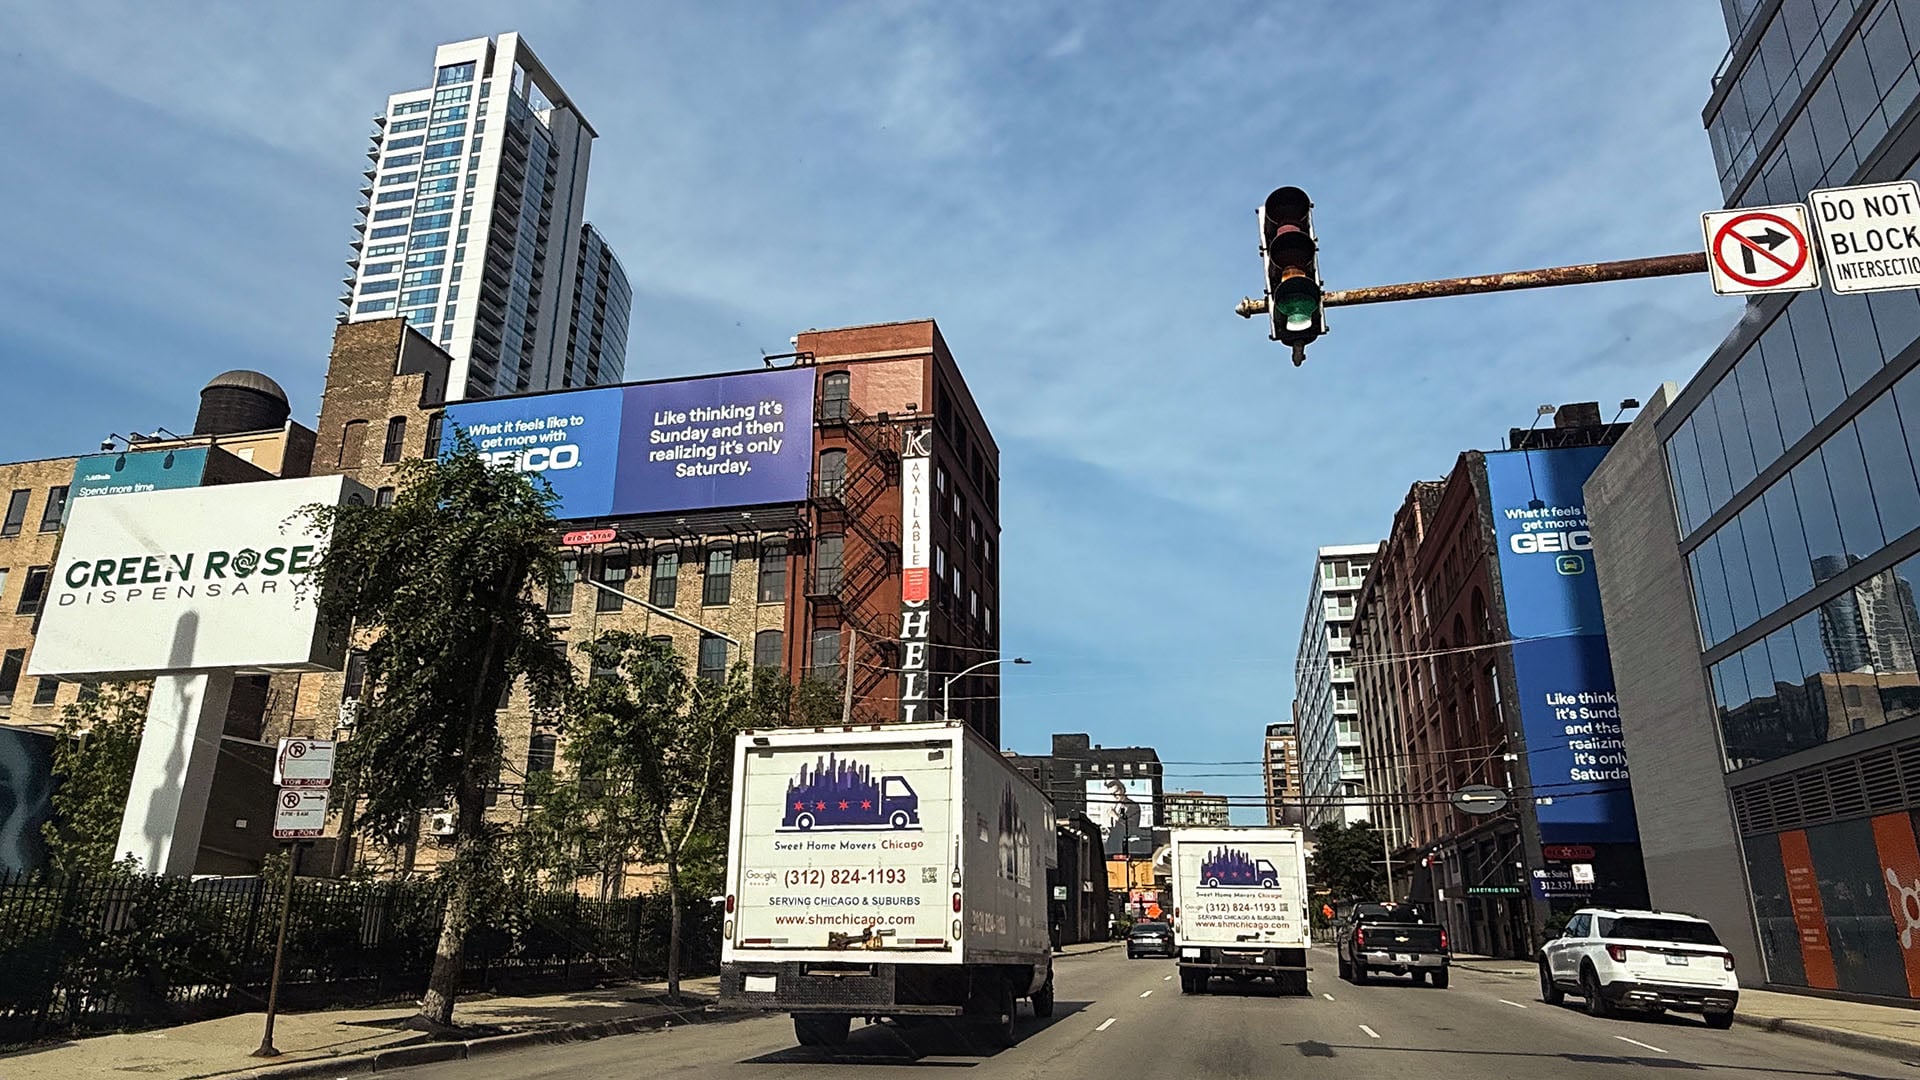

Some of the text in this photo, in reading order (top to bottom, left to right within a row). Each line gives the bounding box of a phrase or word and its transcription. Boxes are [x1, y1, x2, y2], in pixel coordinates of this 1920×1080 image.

[1821, 193, 1910, 221] DO NOT
[1831, 227, 1920, 254] BLOCK
[654, 400, 783, 426] Like thinking it's
[468, 414, 584, 437] What it feels like to
[650, 419, 784, 444] Sunday and then
[481, 429, 567, 449] get more with
[649, 436, 783, 462] realizing it's only
[675, 458, 752, 478] Saturday.
[79, 483, 155, 498] Spend more time
[912, 462, 921, 566] AVAILABLE
[1504, 508, 1539, 519] What
[1551, 506, 1581, 517] feels
[1522, 520, 1544, 532] get
[1544, 519, 1577, 529] more
[65, 552, 194, 589] GREEN
[58, 577, 306, 607] DISPENSARY
[1546, 692, 1576, 705] Like
[1555, 707, 1621, 720] it's Sund
[1565, 722, 1593, 735] and
[1574, 752, 1596, 765] it's
[774, 839, 924, 851] Sweet Home Movers Chicago
[746, 870, 777, 882] Google
[784, 868, 906, 888] (312) 824-1193
[769, 897, 921, 906] SERVING CHICAGO & SUBURBS
[1205, 903, 1276, 913] (312) 824-1193
[775, 914, 915, 926] www.shmchicago.com
[1195, 921, 1290, 930] www.shmchicago.com
